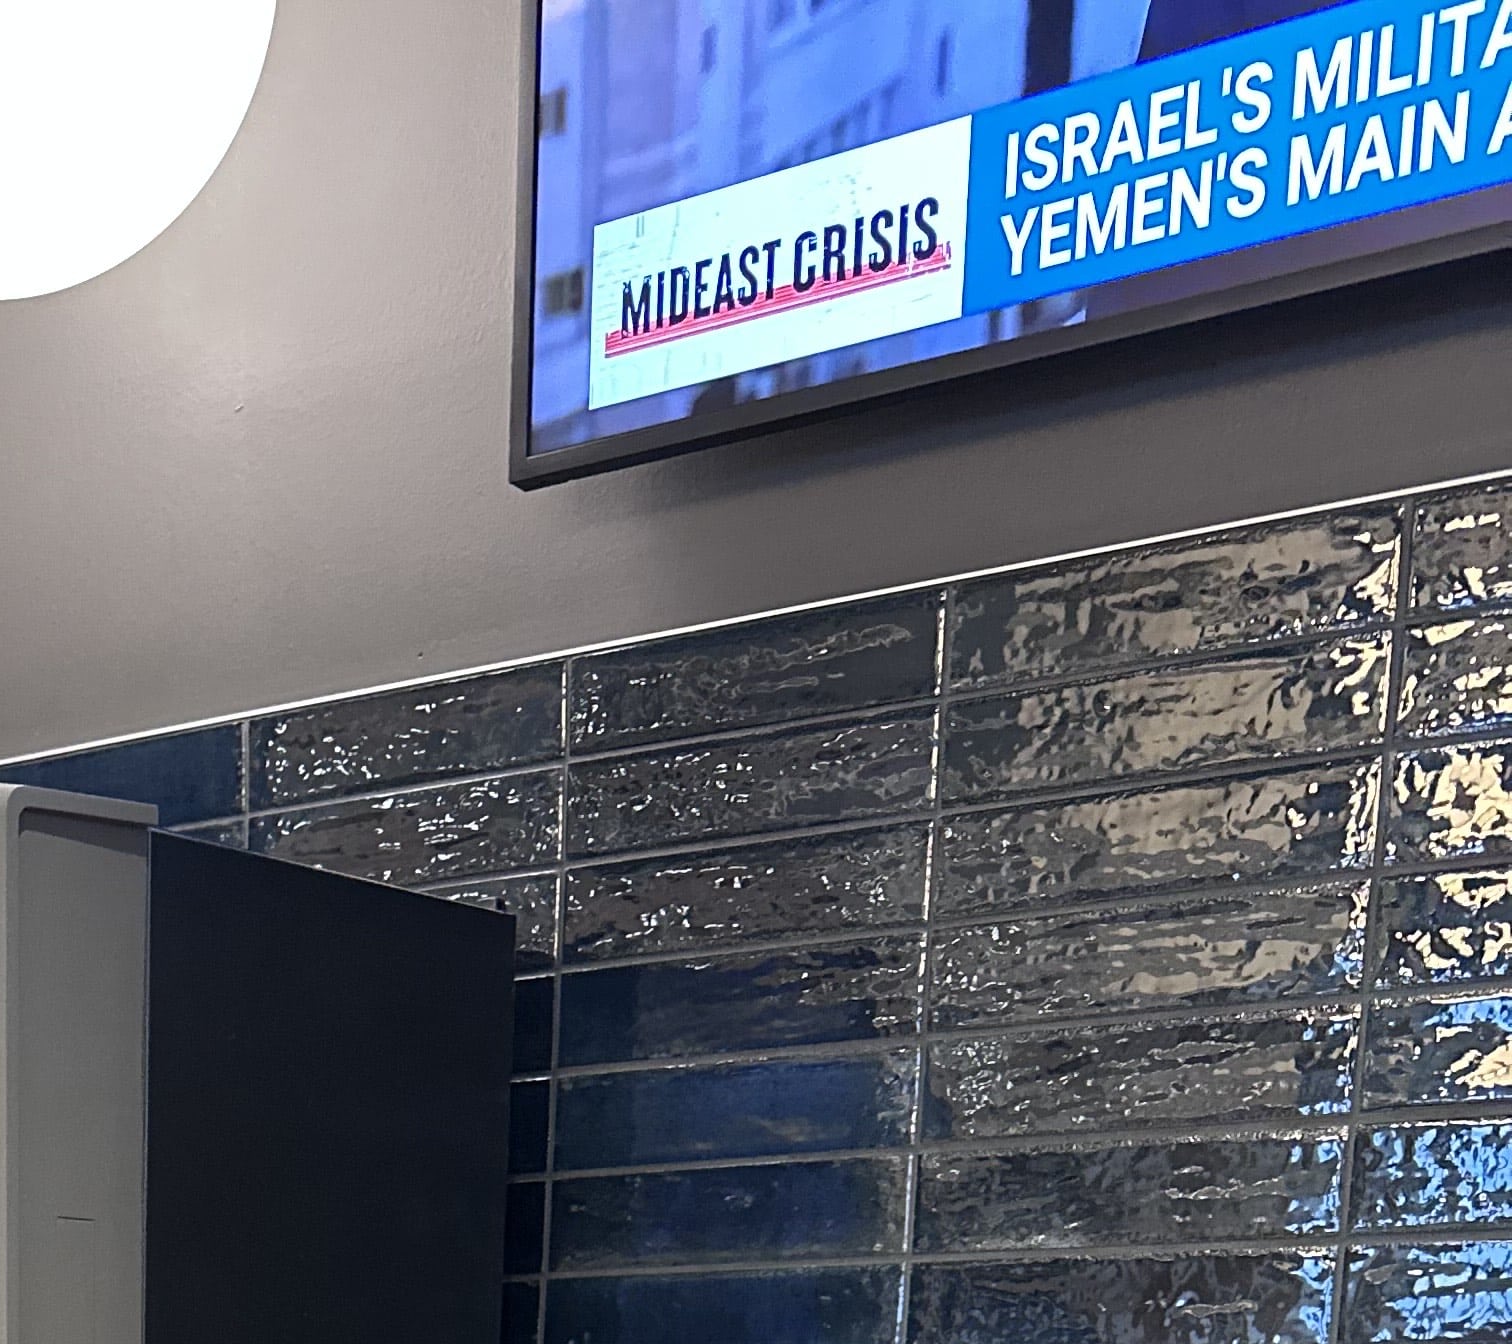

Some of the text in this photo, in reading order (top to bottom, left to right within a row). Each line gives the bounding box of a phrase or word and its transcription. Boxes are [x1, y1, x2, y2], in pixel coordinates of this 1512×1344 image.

[999, 146, 1269, 277] YEMEN'S
[1286, 89, 1471, 207] MAIN
[1004, 61, 1274, 199] ISRAEL'S
[621, 197, 939, 339] MIDEAST CRISIS
